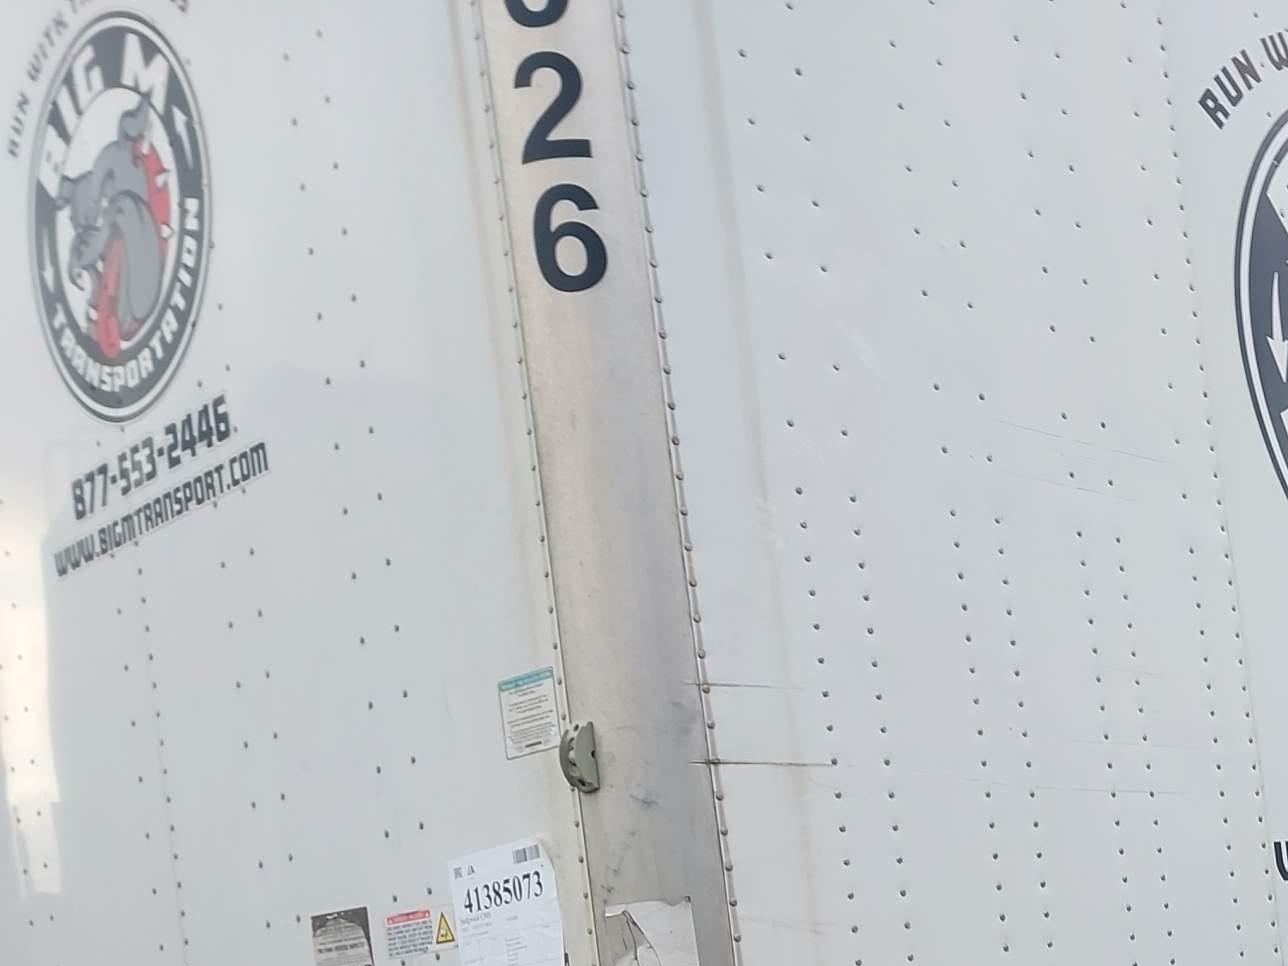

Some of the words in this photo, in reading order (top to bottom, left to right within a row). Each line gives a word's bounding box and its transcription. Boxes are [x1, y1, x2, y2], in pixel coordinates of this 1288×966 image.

[37, 44, 105, 200] BIG
[121, 32, 170, 117] M
[504, 0, 608, 293] 26
[1198, 49, 1262, 130] RUN
[51, 196, 200, 394] TRANSPORTATION
[70, 395, 231, 521] 877-553-2446
[463, 870, 544, 914] 41385073
